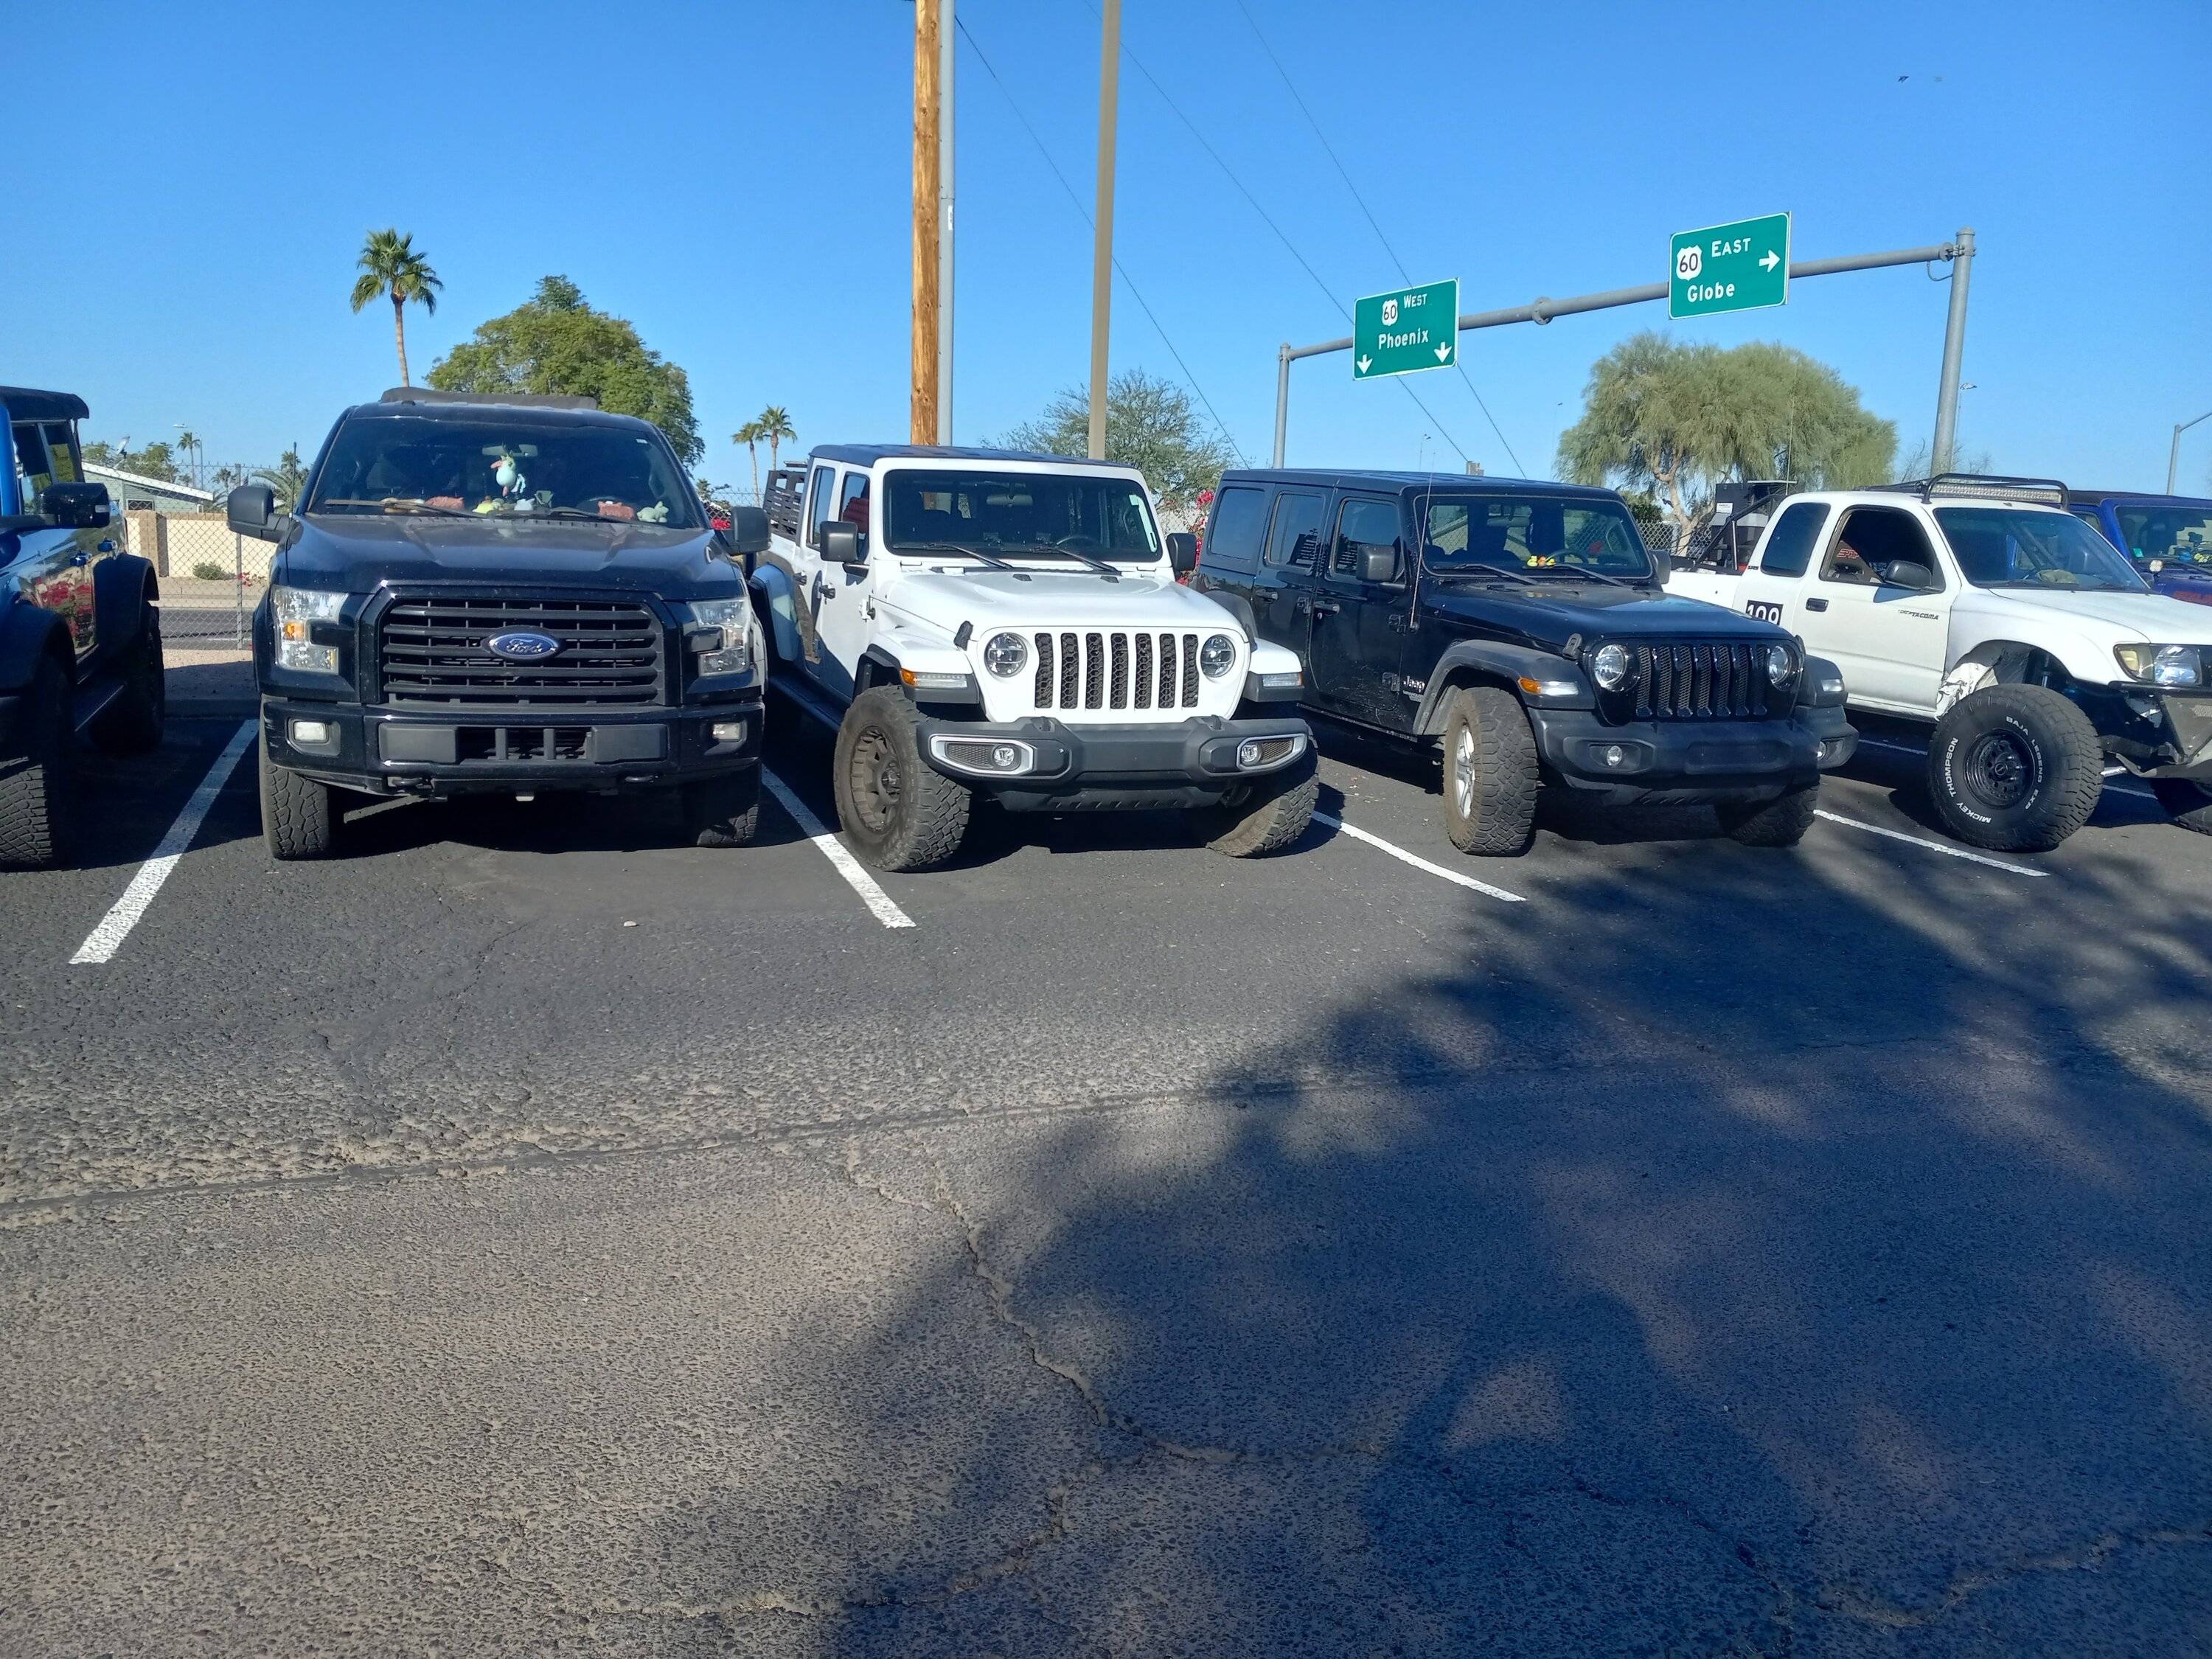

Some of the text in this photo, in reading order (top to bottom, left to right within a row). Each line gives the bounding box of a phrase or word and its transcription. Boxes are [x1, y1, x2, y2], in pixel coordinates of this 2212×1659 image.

[1680, 237, 1751, 273] 60 EAST
[1687, 282, 1735, 302] Globe
[1384, 293, 1427, 320] 60 WEST
[1378, 327, 1429, 350] Phoenix
[1911, 612, 1938, 620] TACOMA
[507, 639, 543, 653] Ford
[1403, 675, 1425, 693] Jeep
[2006, 716, 2042, 810] BAJA LEGEND EXP
[1945, 737, 1992, 824] MICKEY THOMPSON
